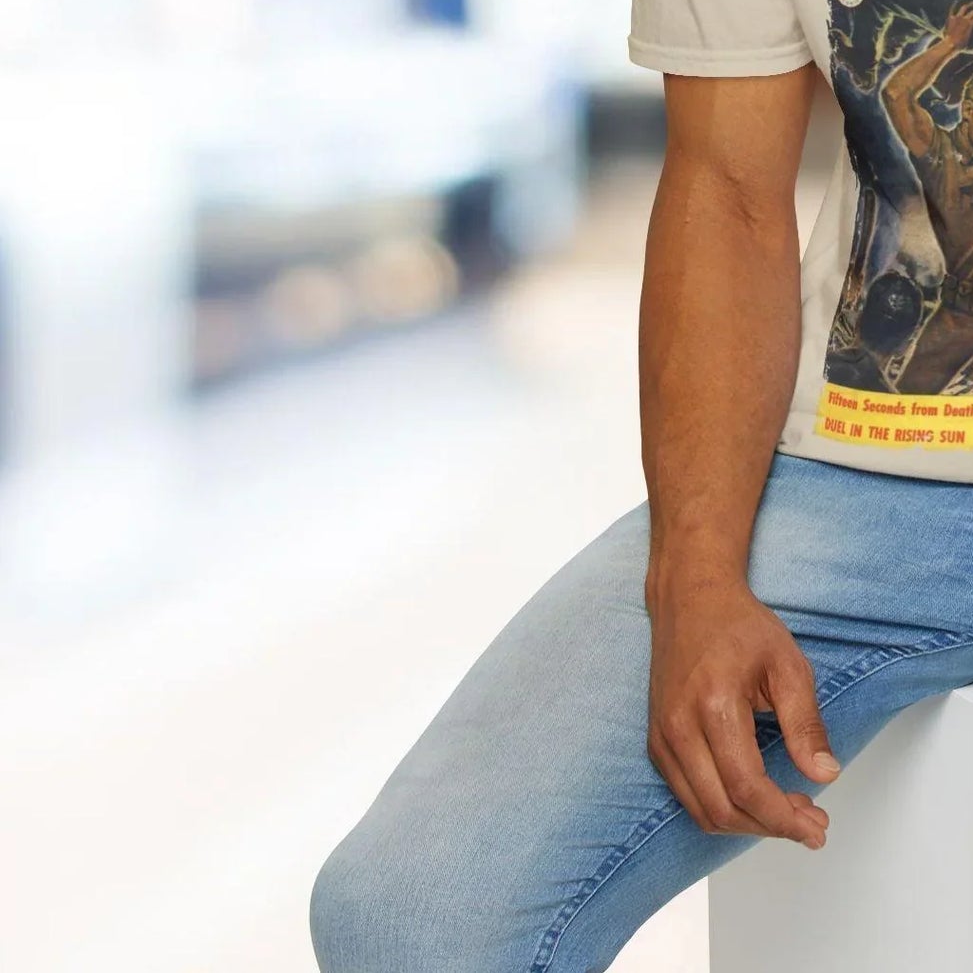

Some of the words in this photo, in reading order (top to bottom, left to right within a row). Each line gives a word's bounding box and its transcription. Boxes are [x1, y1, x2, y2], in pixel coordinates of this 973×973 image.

[828, 390, 859, 411] Fifteen
[863, 398, 907, 416] Seconds
[911, 401, 939, 416] from
[824, 416, 847, 435] DUEL
[849, 423, 863, 438] IN
[868, 425, 890, 441] THE
[894, 428, 935, 443] RISING
[939, 430, 966, 444] SUN
